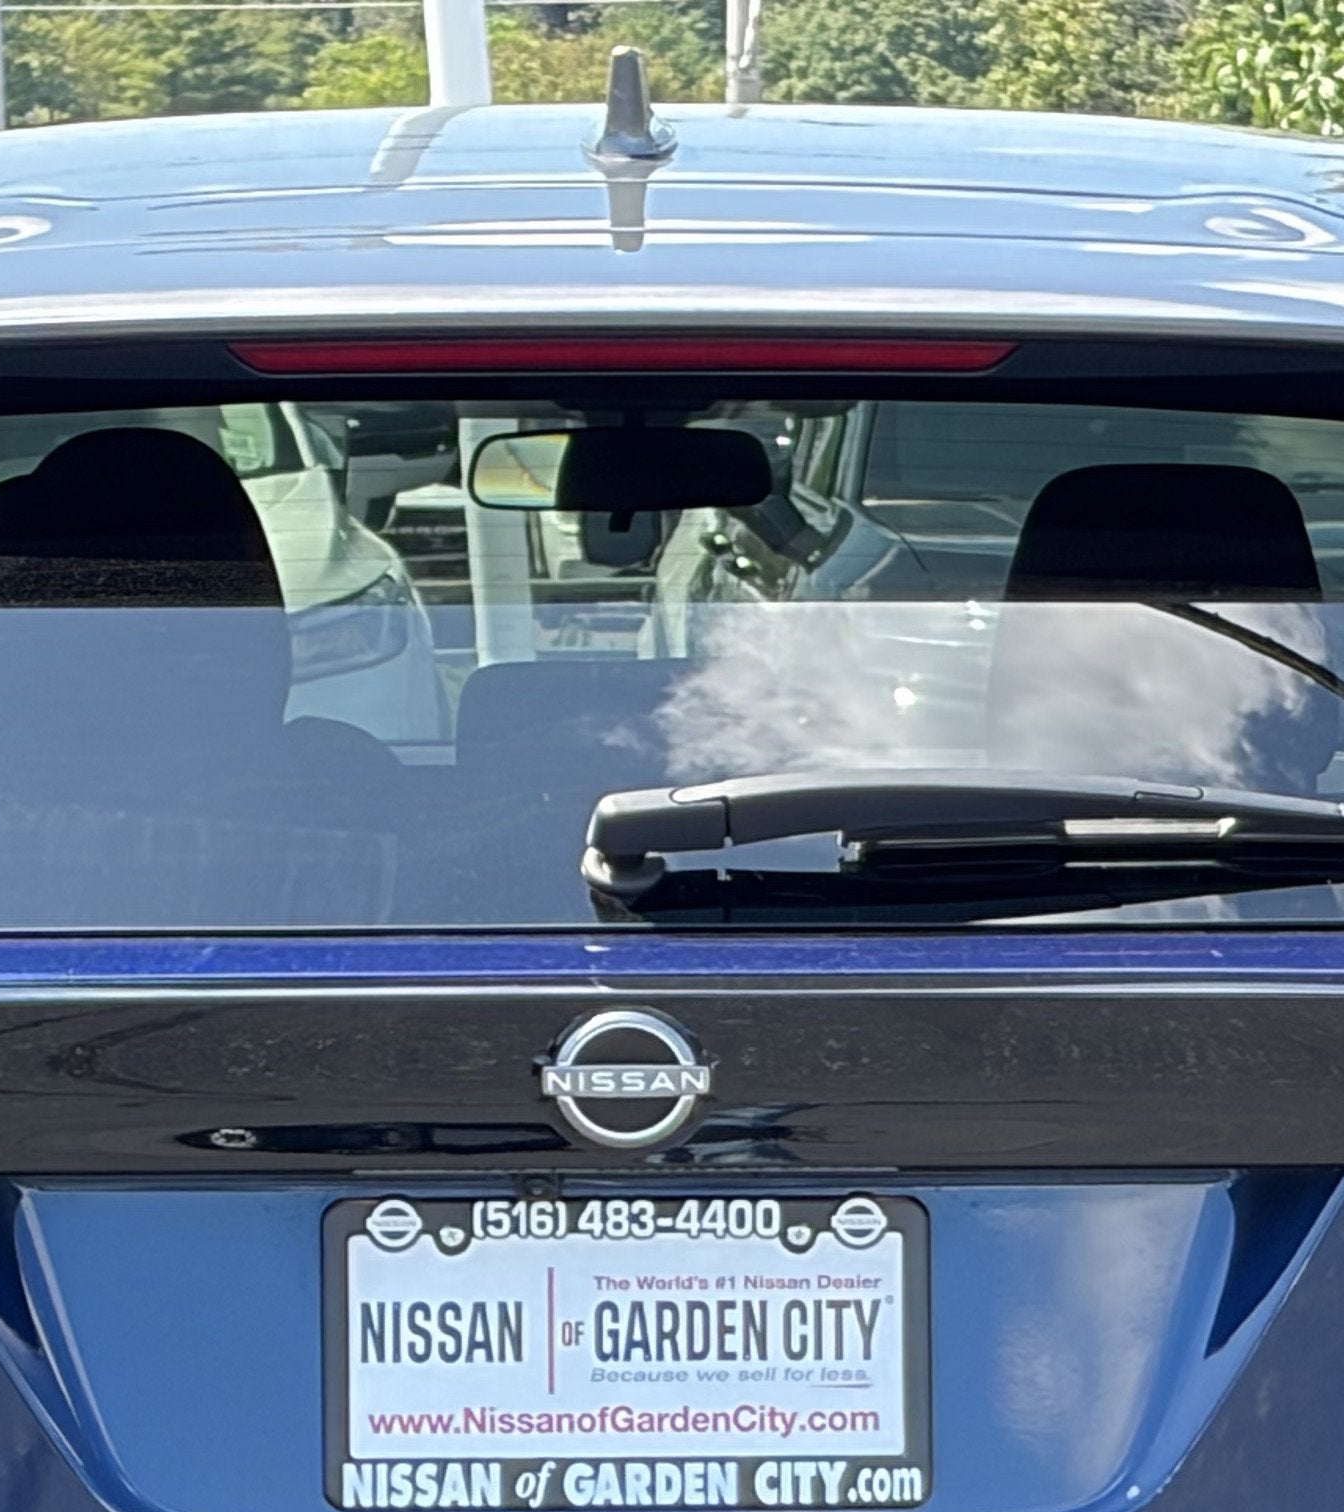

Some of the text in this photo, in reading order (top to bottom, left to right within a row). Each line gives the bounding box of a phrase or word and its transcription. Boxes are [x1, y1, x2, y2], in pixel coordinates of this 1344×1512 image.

[546, 1070, 705, 1092] NISSAN
[473, 1199, 780, 1239] (516) 483-4400
[593, 1274, 882, 1291] The World's #1 Nissan Dealer
[360, 1299, 882, 1363] NISSAN OF GARDEN CITY
[590, 1367, 689, 1383] Because
[696, 1369, 730, 1383] we
[737, 1367, 777, 1383] sell
[783, 1367, 814, 1382] for
[367, 1405, 880, 1438] www.NissanofGardenCity.com
[342, 1462, 502, 1509] NISSAN
[515, 1460, 557, 1509] of
[563, 1461, 739, 1507] GARDEN
